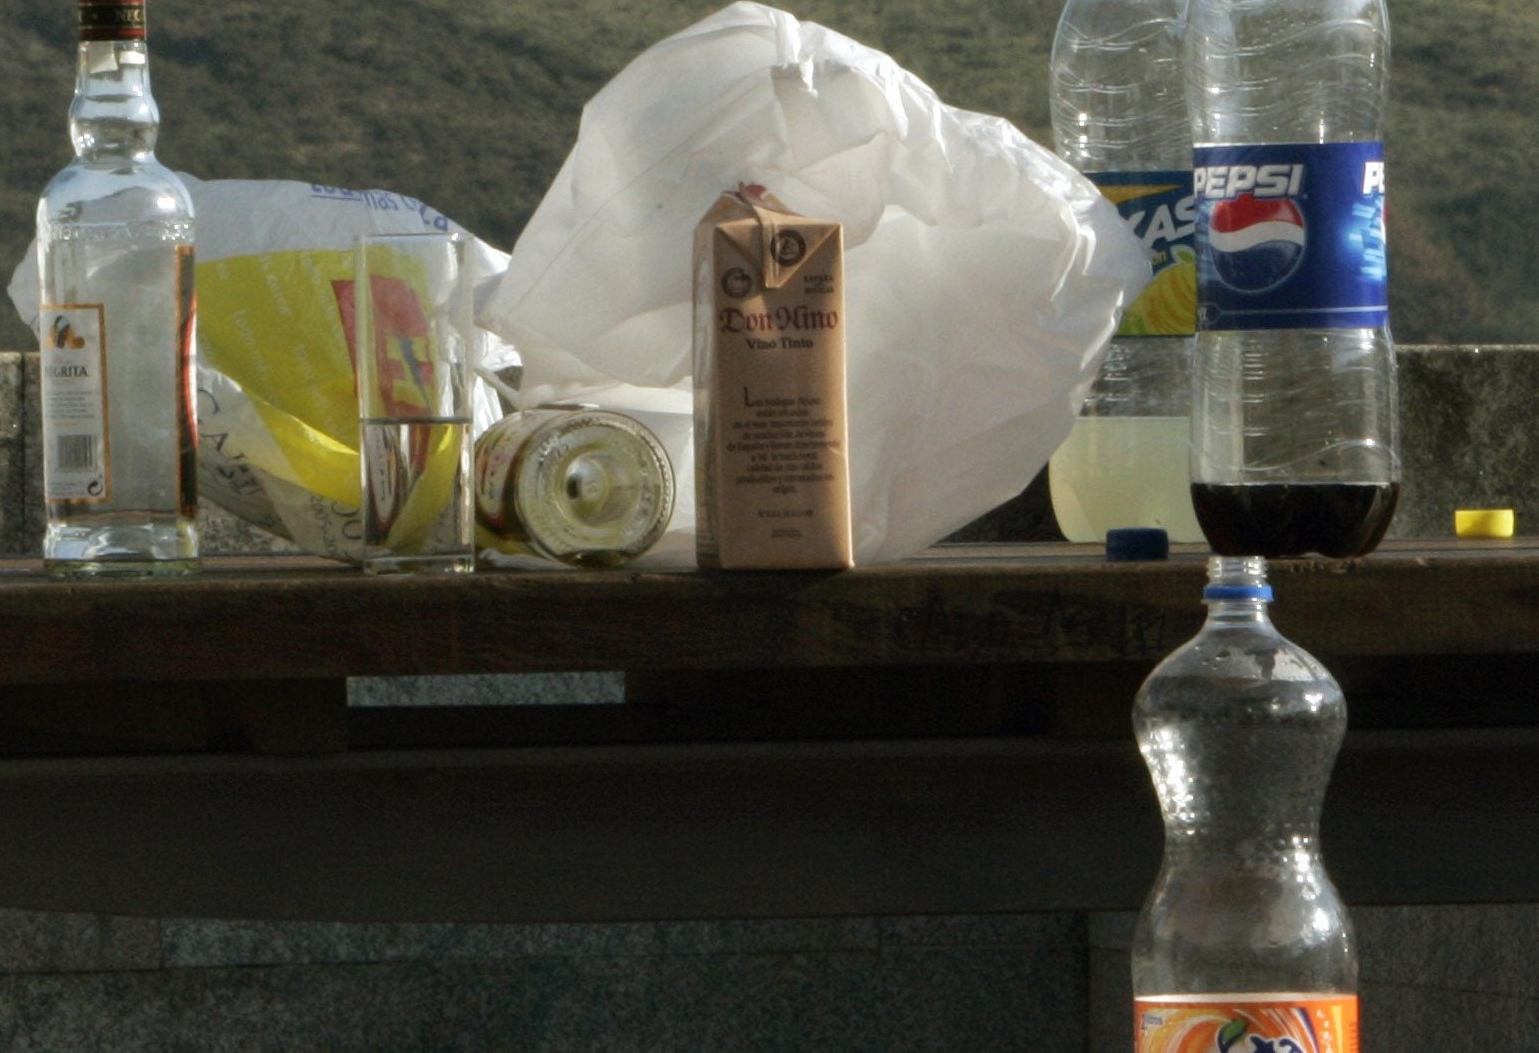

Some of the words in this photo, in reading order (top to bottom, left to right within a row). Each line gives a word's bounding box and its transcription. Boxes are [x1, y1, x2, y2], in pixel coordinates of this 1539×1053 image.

[1193, 163, 1305, 198] PEPSI
[719, 306, 774, 334] Don
[746, 336, 777, 350] Vino
[781, 335, 815, 350] Tinto
